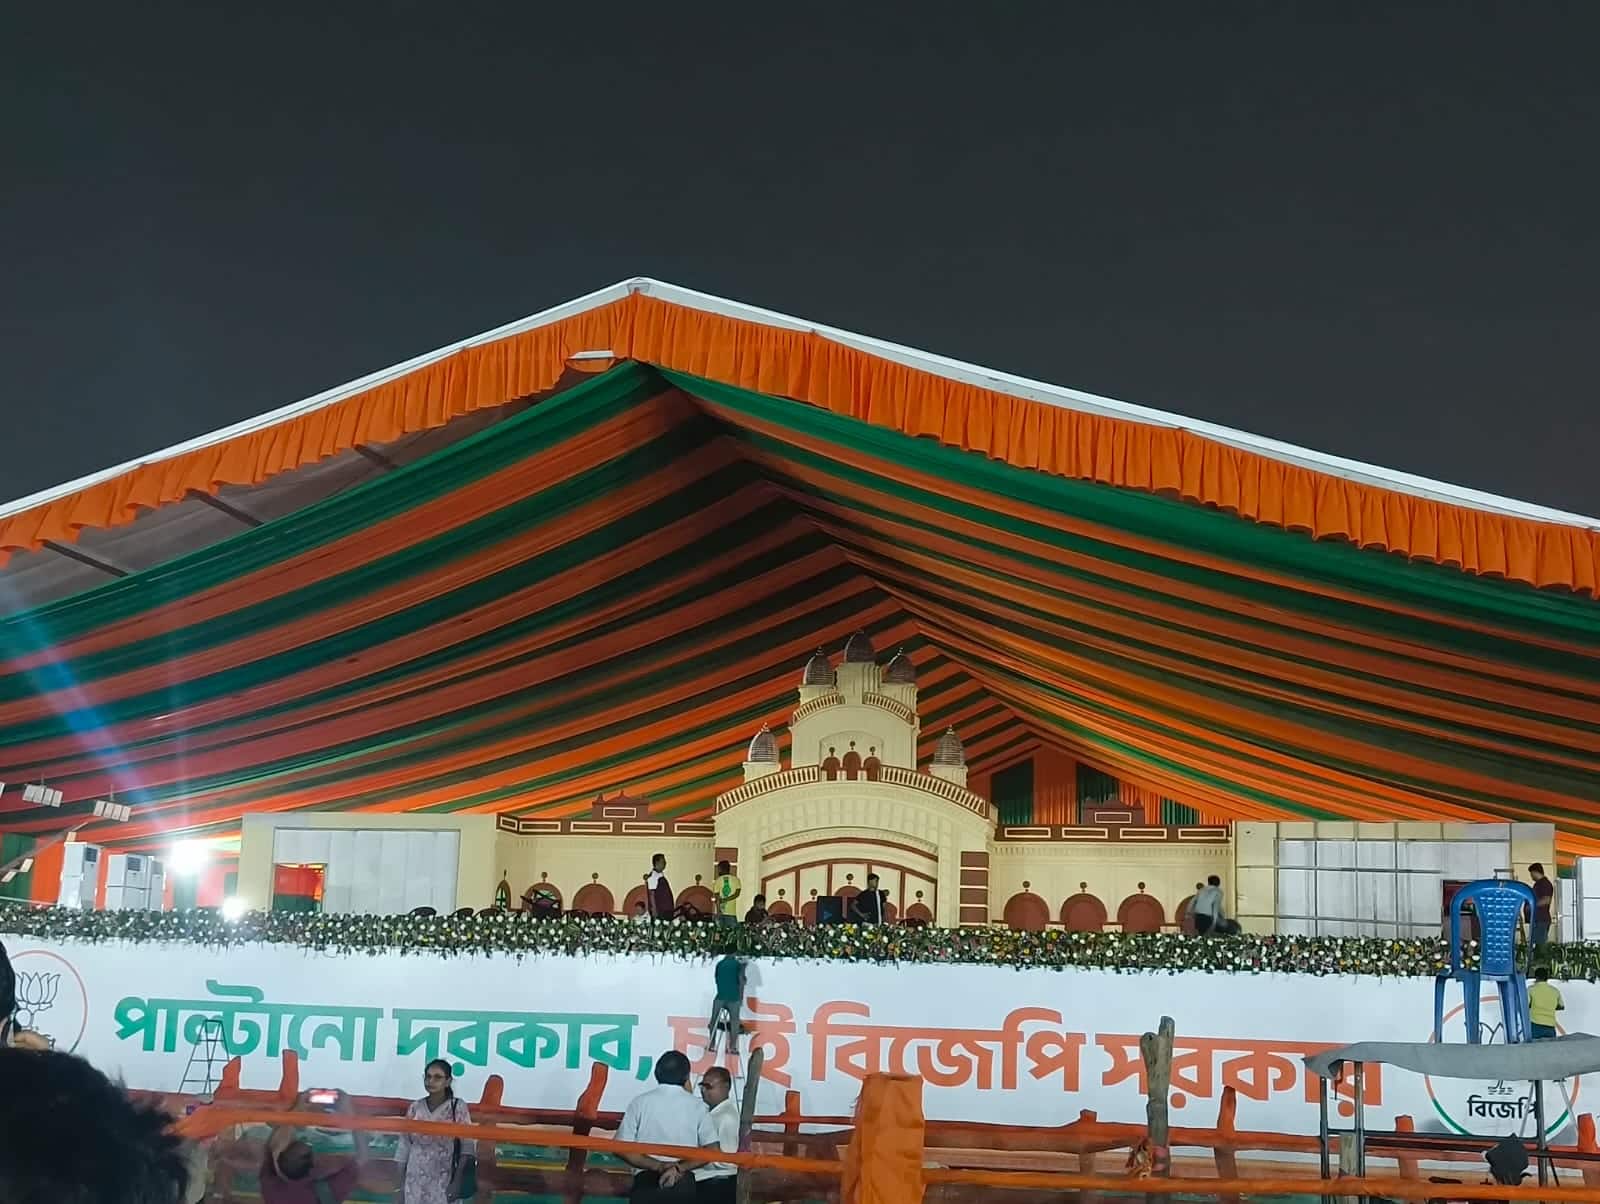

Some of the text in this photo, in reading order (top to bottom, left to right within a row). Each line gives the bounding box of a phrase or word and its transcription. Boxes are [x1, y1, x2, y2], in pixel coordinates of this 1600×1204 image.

[114, 979, 384, 1062] পাল্টানো
[806, 1000, 1086, 1092] বিজেপি
[1467, 1094, 1538, 1119] বিজেপি
